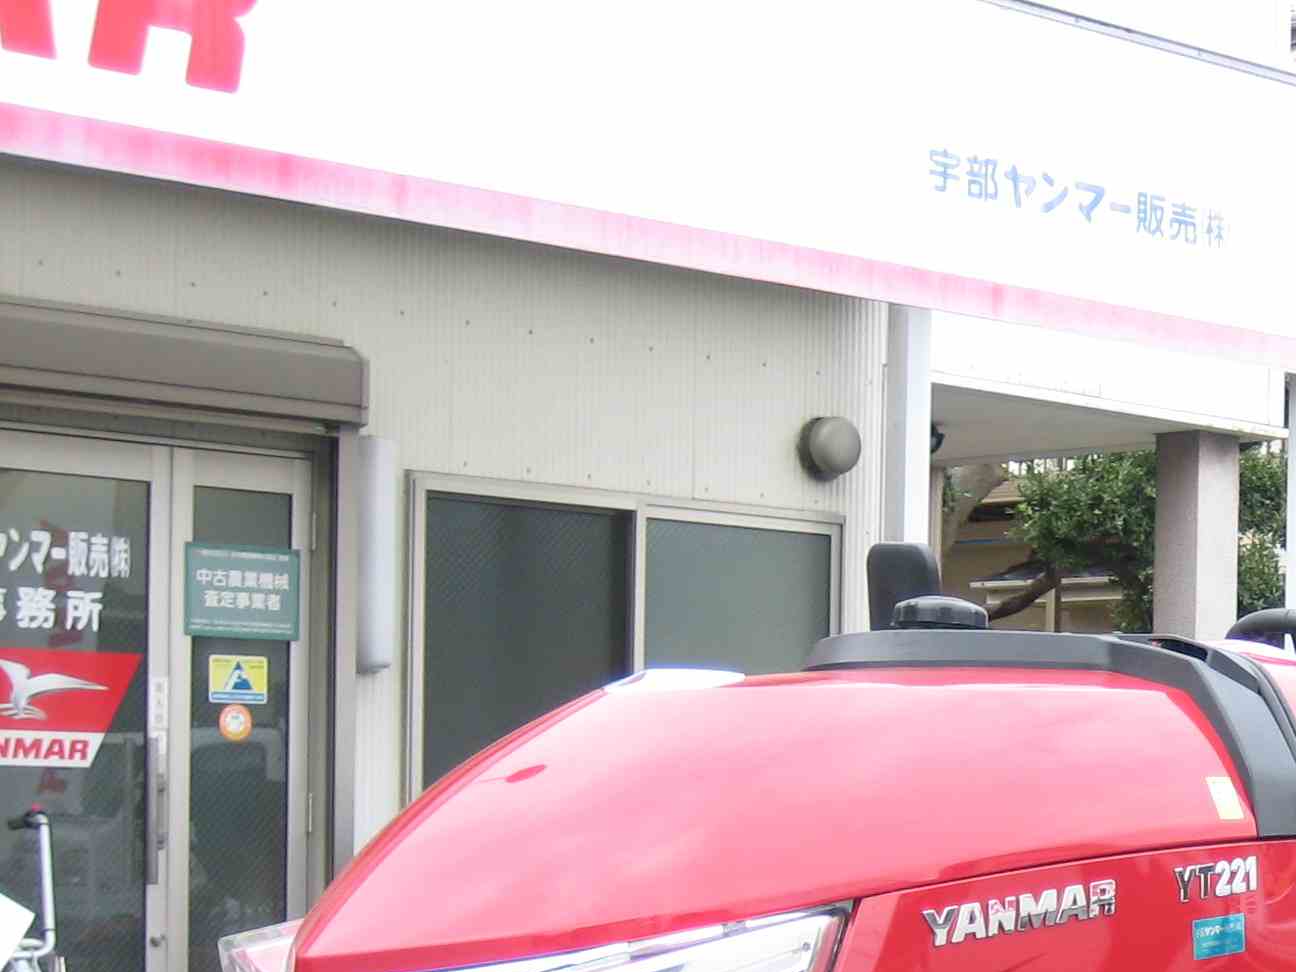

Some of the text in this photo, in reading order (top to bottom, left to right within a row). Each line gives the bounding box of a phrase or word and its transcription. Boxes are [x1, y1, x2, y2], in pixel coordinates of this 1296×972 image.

[0, 586, 103, 632] 務所
[1173, 855, 1257, 903] YT221
[922, 879, 1117, 947] YANMAR
